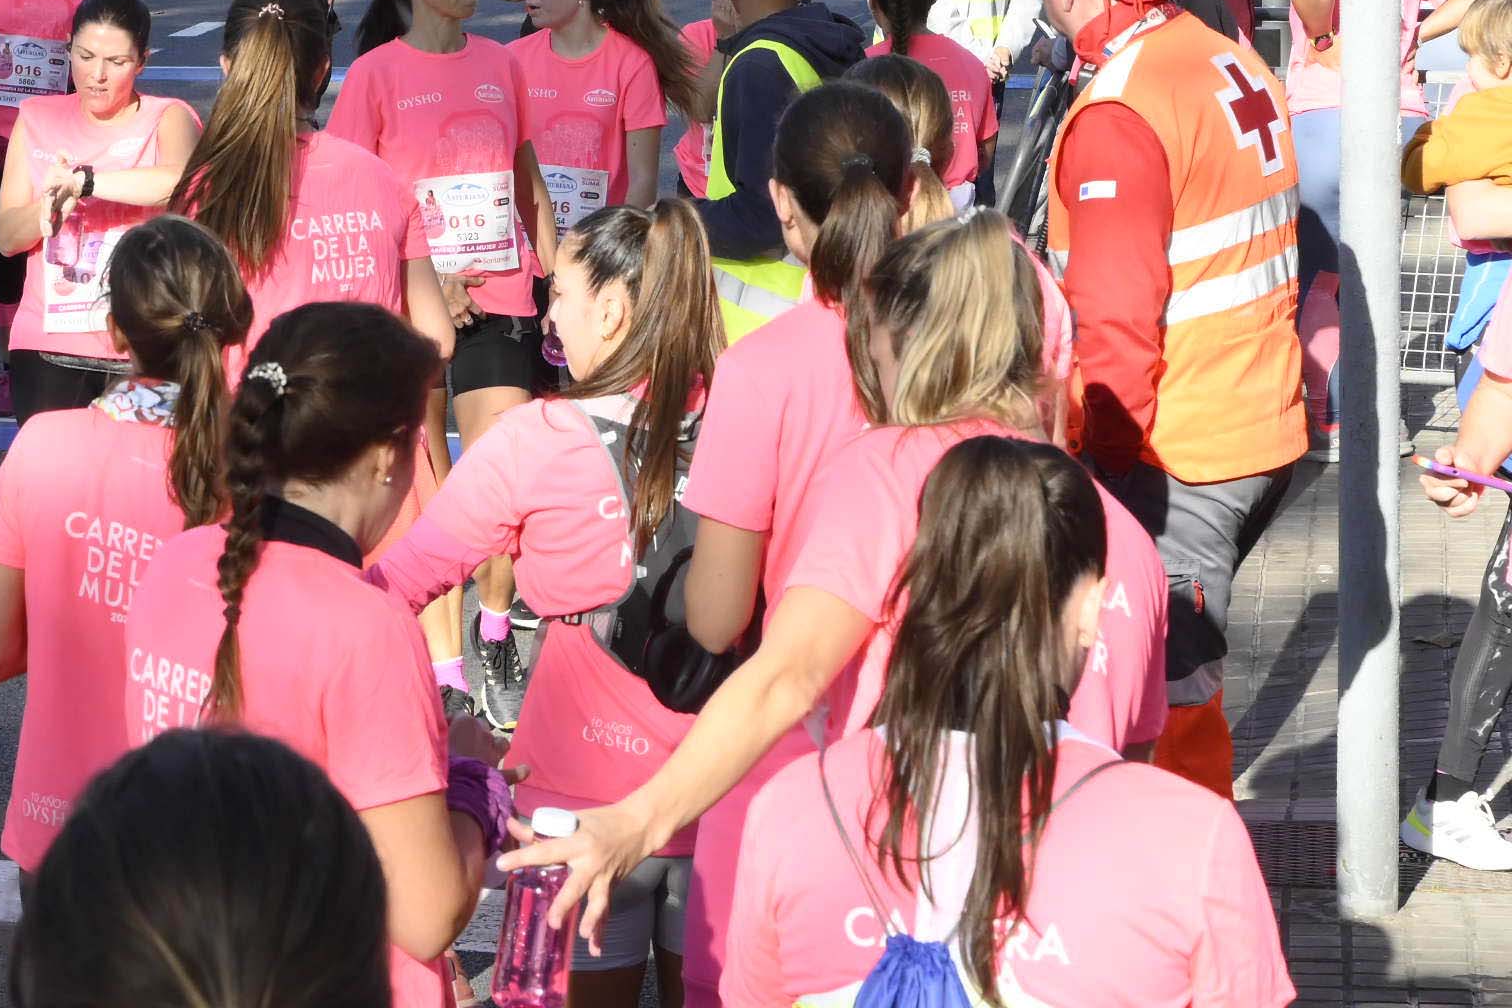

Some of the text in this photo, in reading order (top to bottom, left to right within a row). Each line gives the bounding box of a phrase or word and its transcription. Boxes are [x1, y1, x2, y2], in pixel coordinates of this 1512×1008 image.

[14, 64, 42, 77] 016
[397, 92, 442, 111] OYSHO
[291, 209, 385, 241] CARRERA
[448, 214, 486, 230] 016
[313, 233, 371, 260] DE LA
[311, 256, 377, 285] MUJER
[88, 545, 123, 576] DE
[142, 689, 170, 728] DE
